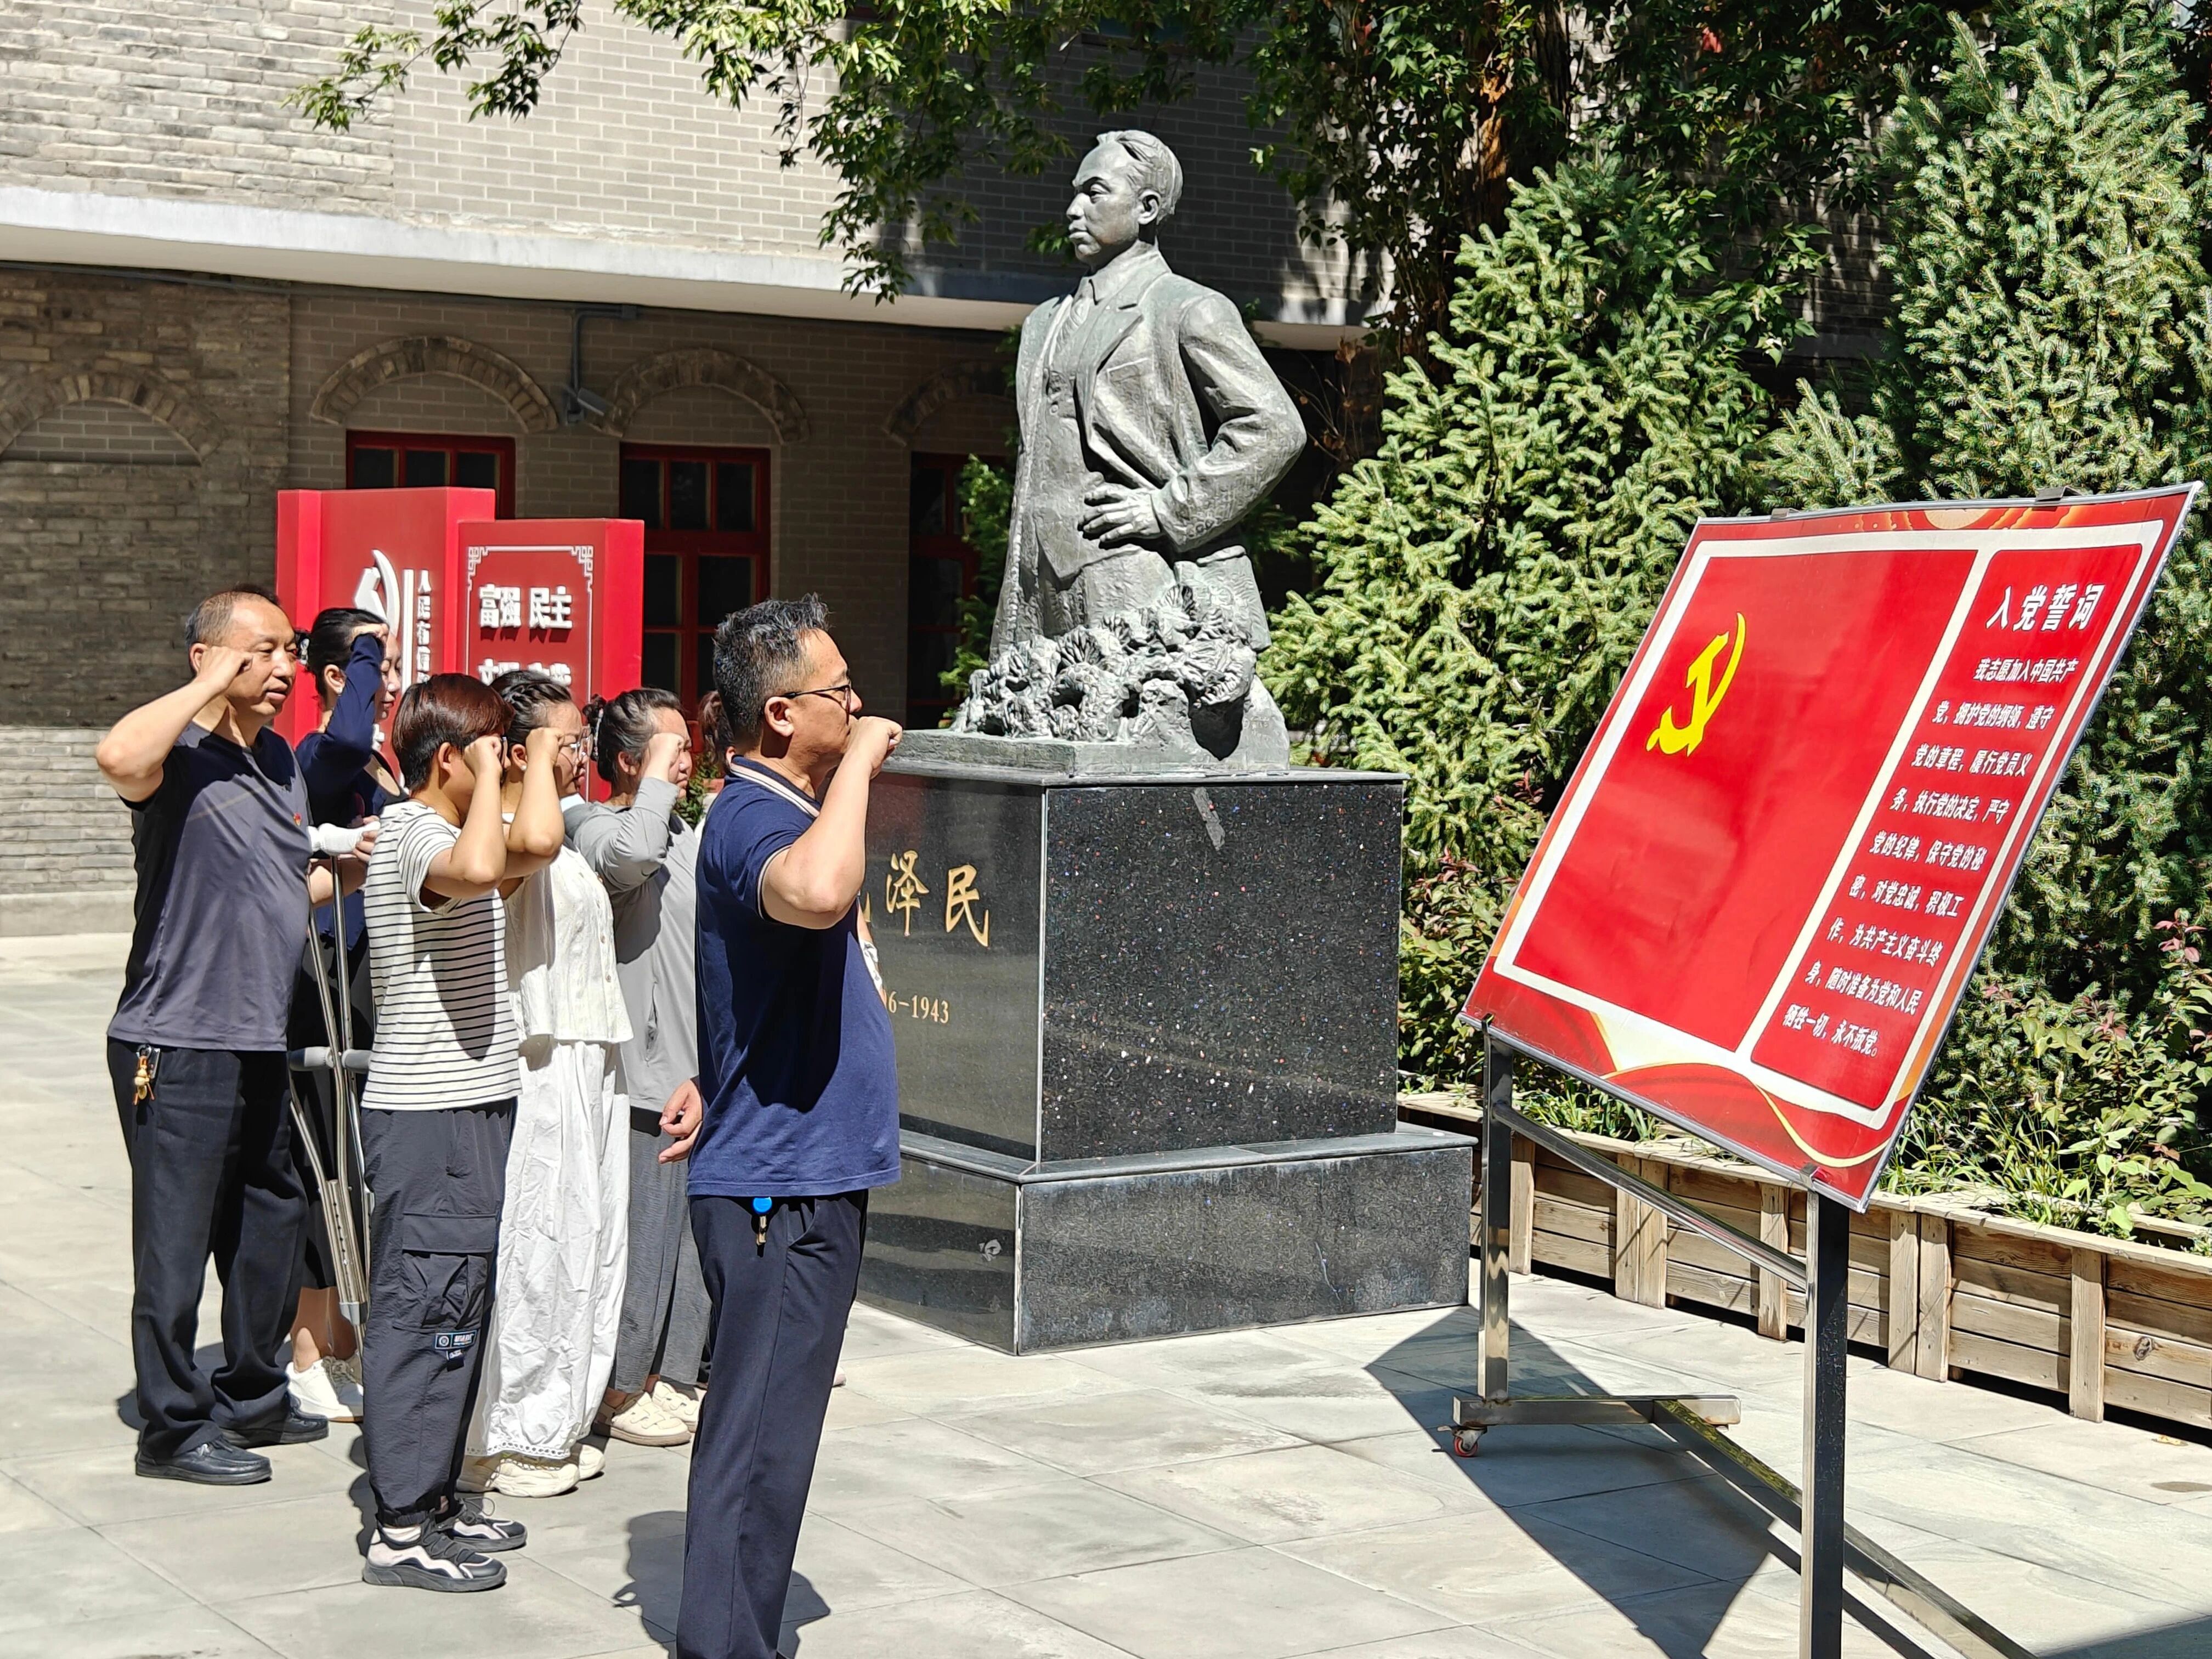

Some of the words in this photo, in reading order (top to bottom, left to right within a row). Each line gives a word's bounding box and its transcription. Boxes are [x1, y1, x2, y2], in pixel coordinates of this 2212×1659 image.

[1985, 583, 2105, 632] 入党誓词
[1973, 658, 2079, 683] 我志愿加入中国共产
[863, 850, 990, 947] 泽民
[884, 989, 949, 1024] 6-1943
